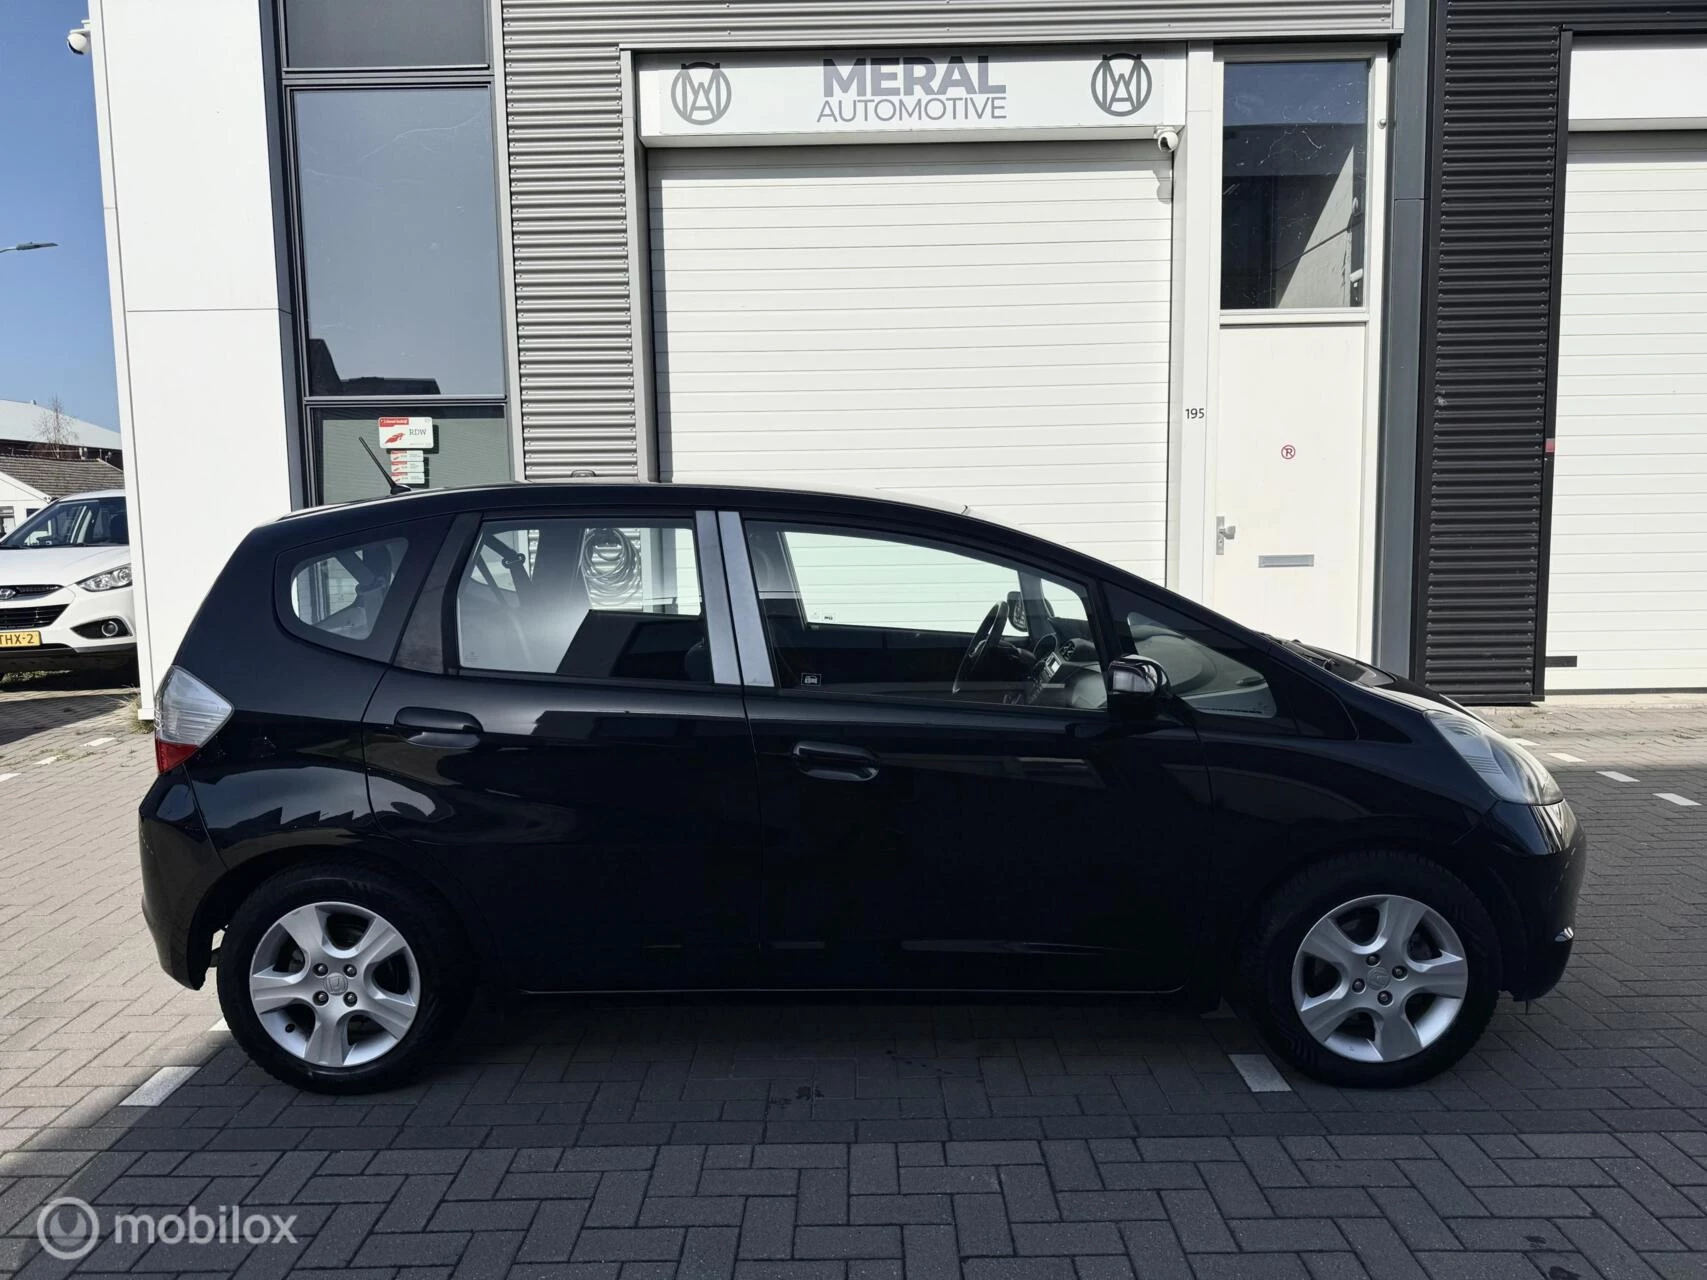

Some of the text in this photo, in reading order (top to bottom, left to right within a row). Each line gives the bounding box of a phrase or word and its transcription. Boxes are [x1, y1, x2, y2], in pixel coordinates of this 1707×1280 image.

[822, 55, 1007, 98] MERAL
[816, 96, 1007, 123] AUTOMOTIVE
[1185, 407, 1205, 419] 195
[409, 428, 427, 436] RDW
